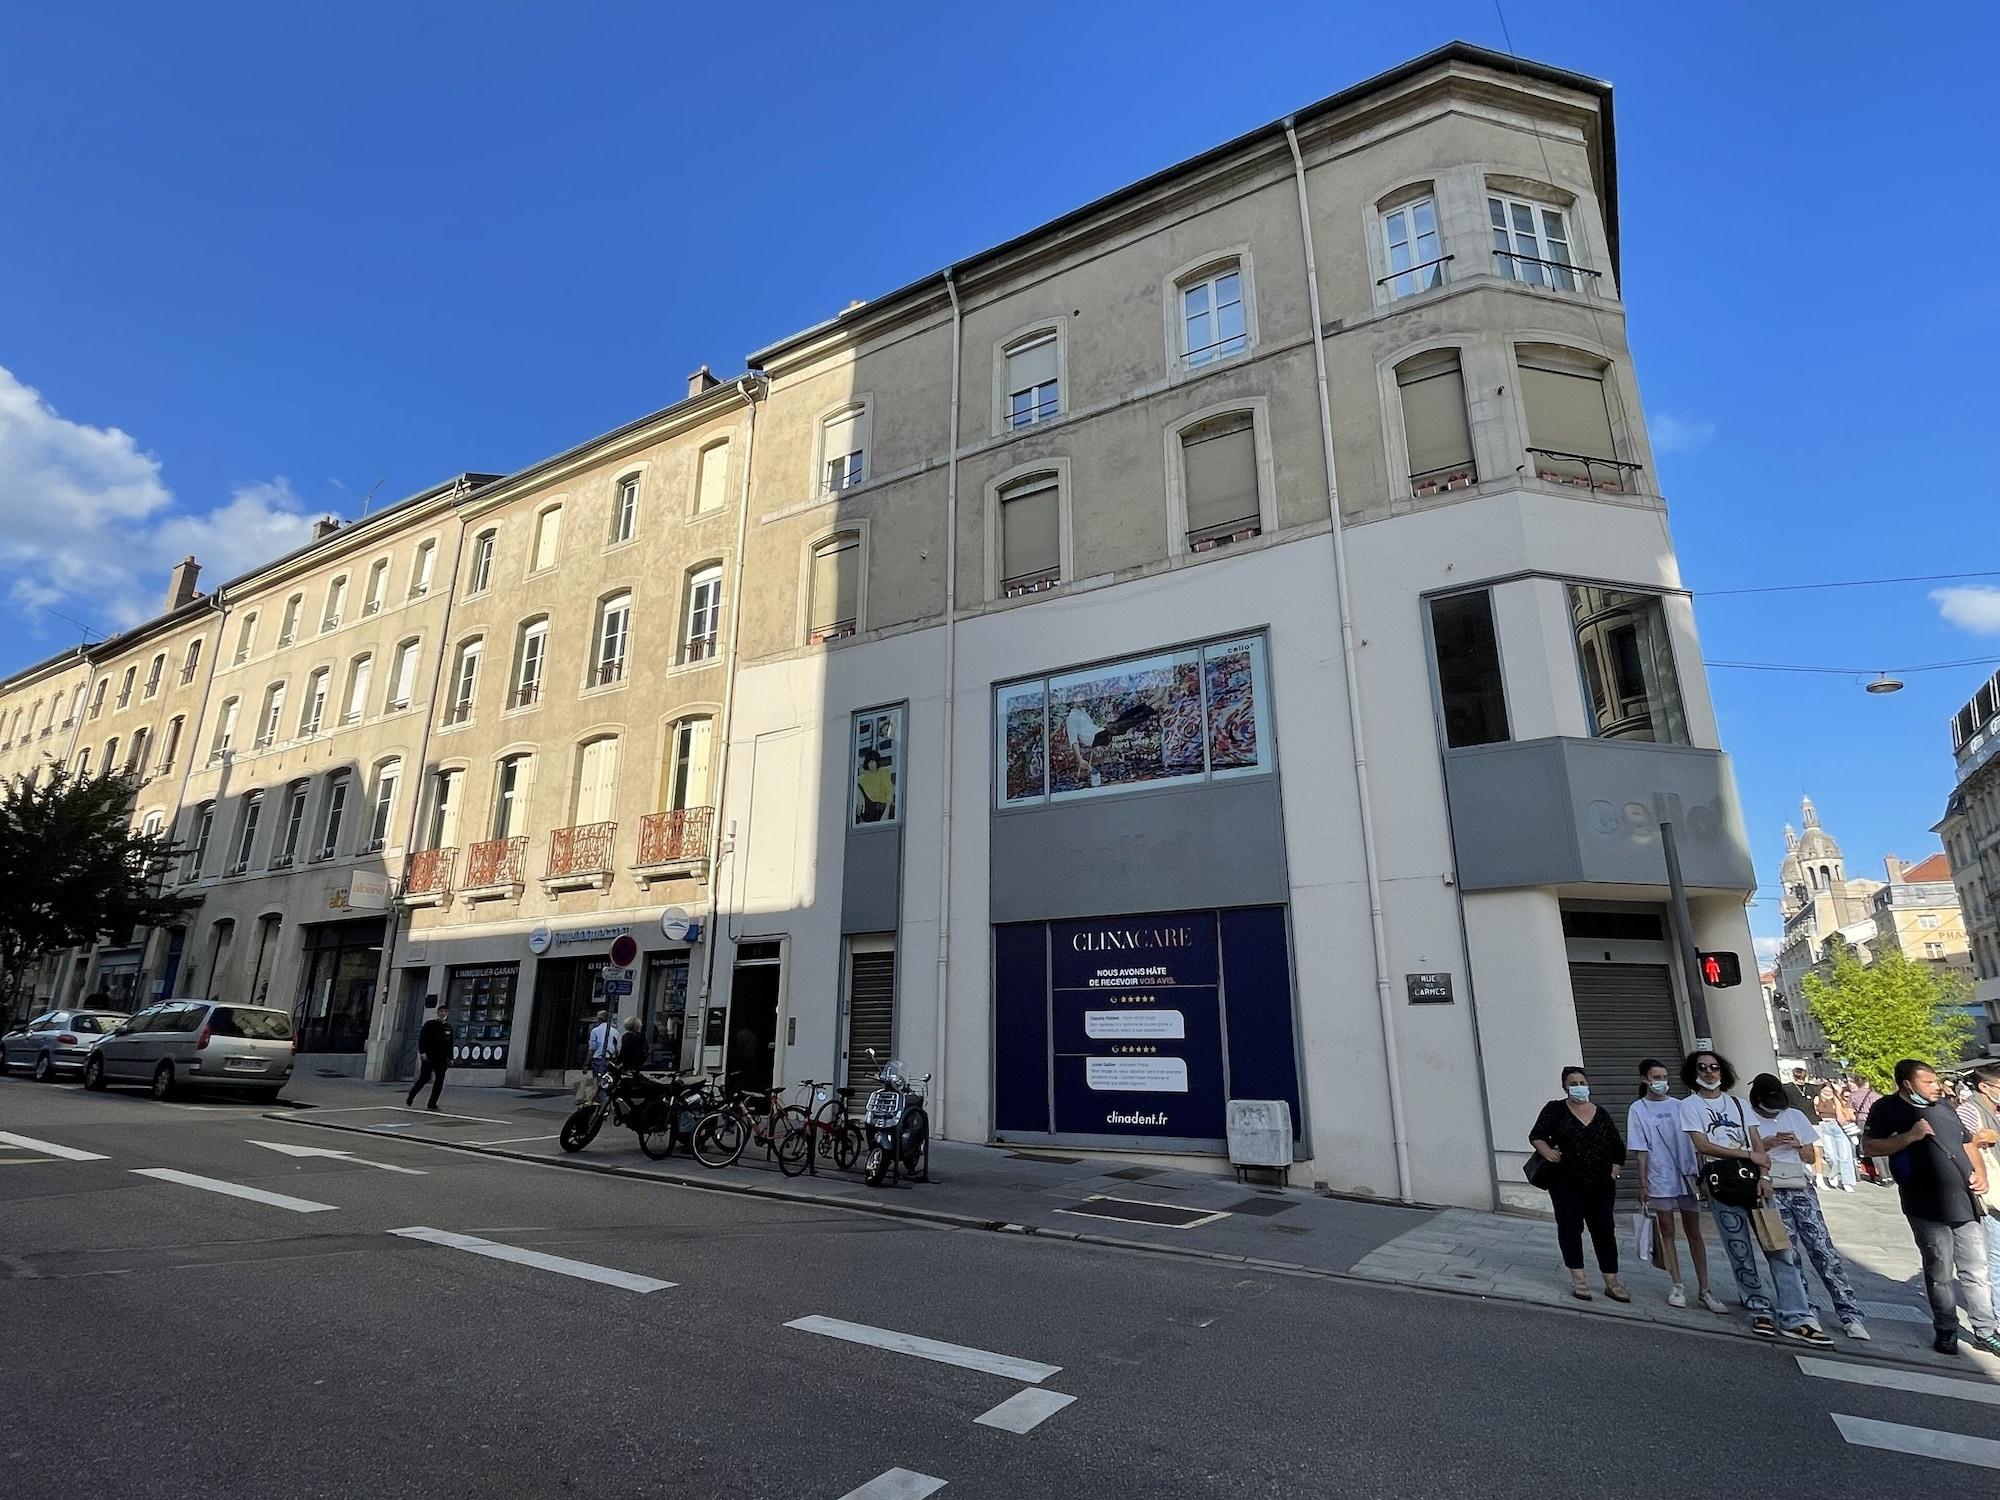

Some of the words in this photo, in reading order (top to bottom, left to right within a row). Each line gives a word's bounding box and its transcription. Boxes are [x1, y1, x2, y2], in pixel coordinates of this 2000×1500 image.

[1073, 927, 1192, 951] CLINACARE
[1097, 968, 1118, 977] NOUS
[1119, 967, 1145, 976] AVONS
[1146, 965, 1167, 975] HÂTE
[1089, 979, 1100, 987] DE
[1101, 978, 1138, 986] RECEVOIR
[1139, 977, 1155, 985] VOS
[1414, 987, 1446, 996] CARMES
[1106, 1110, 1168, 1125] clinadent.fr
